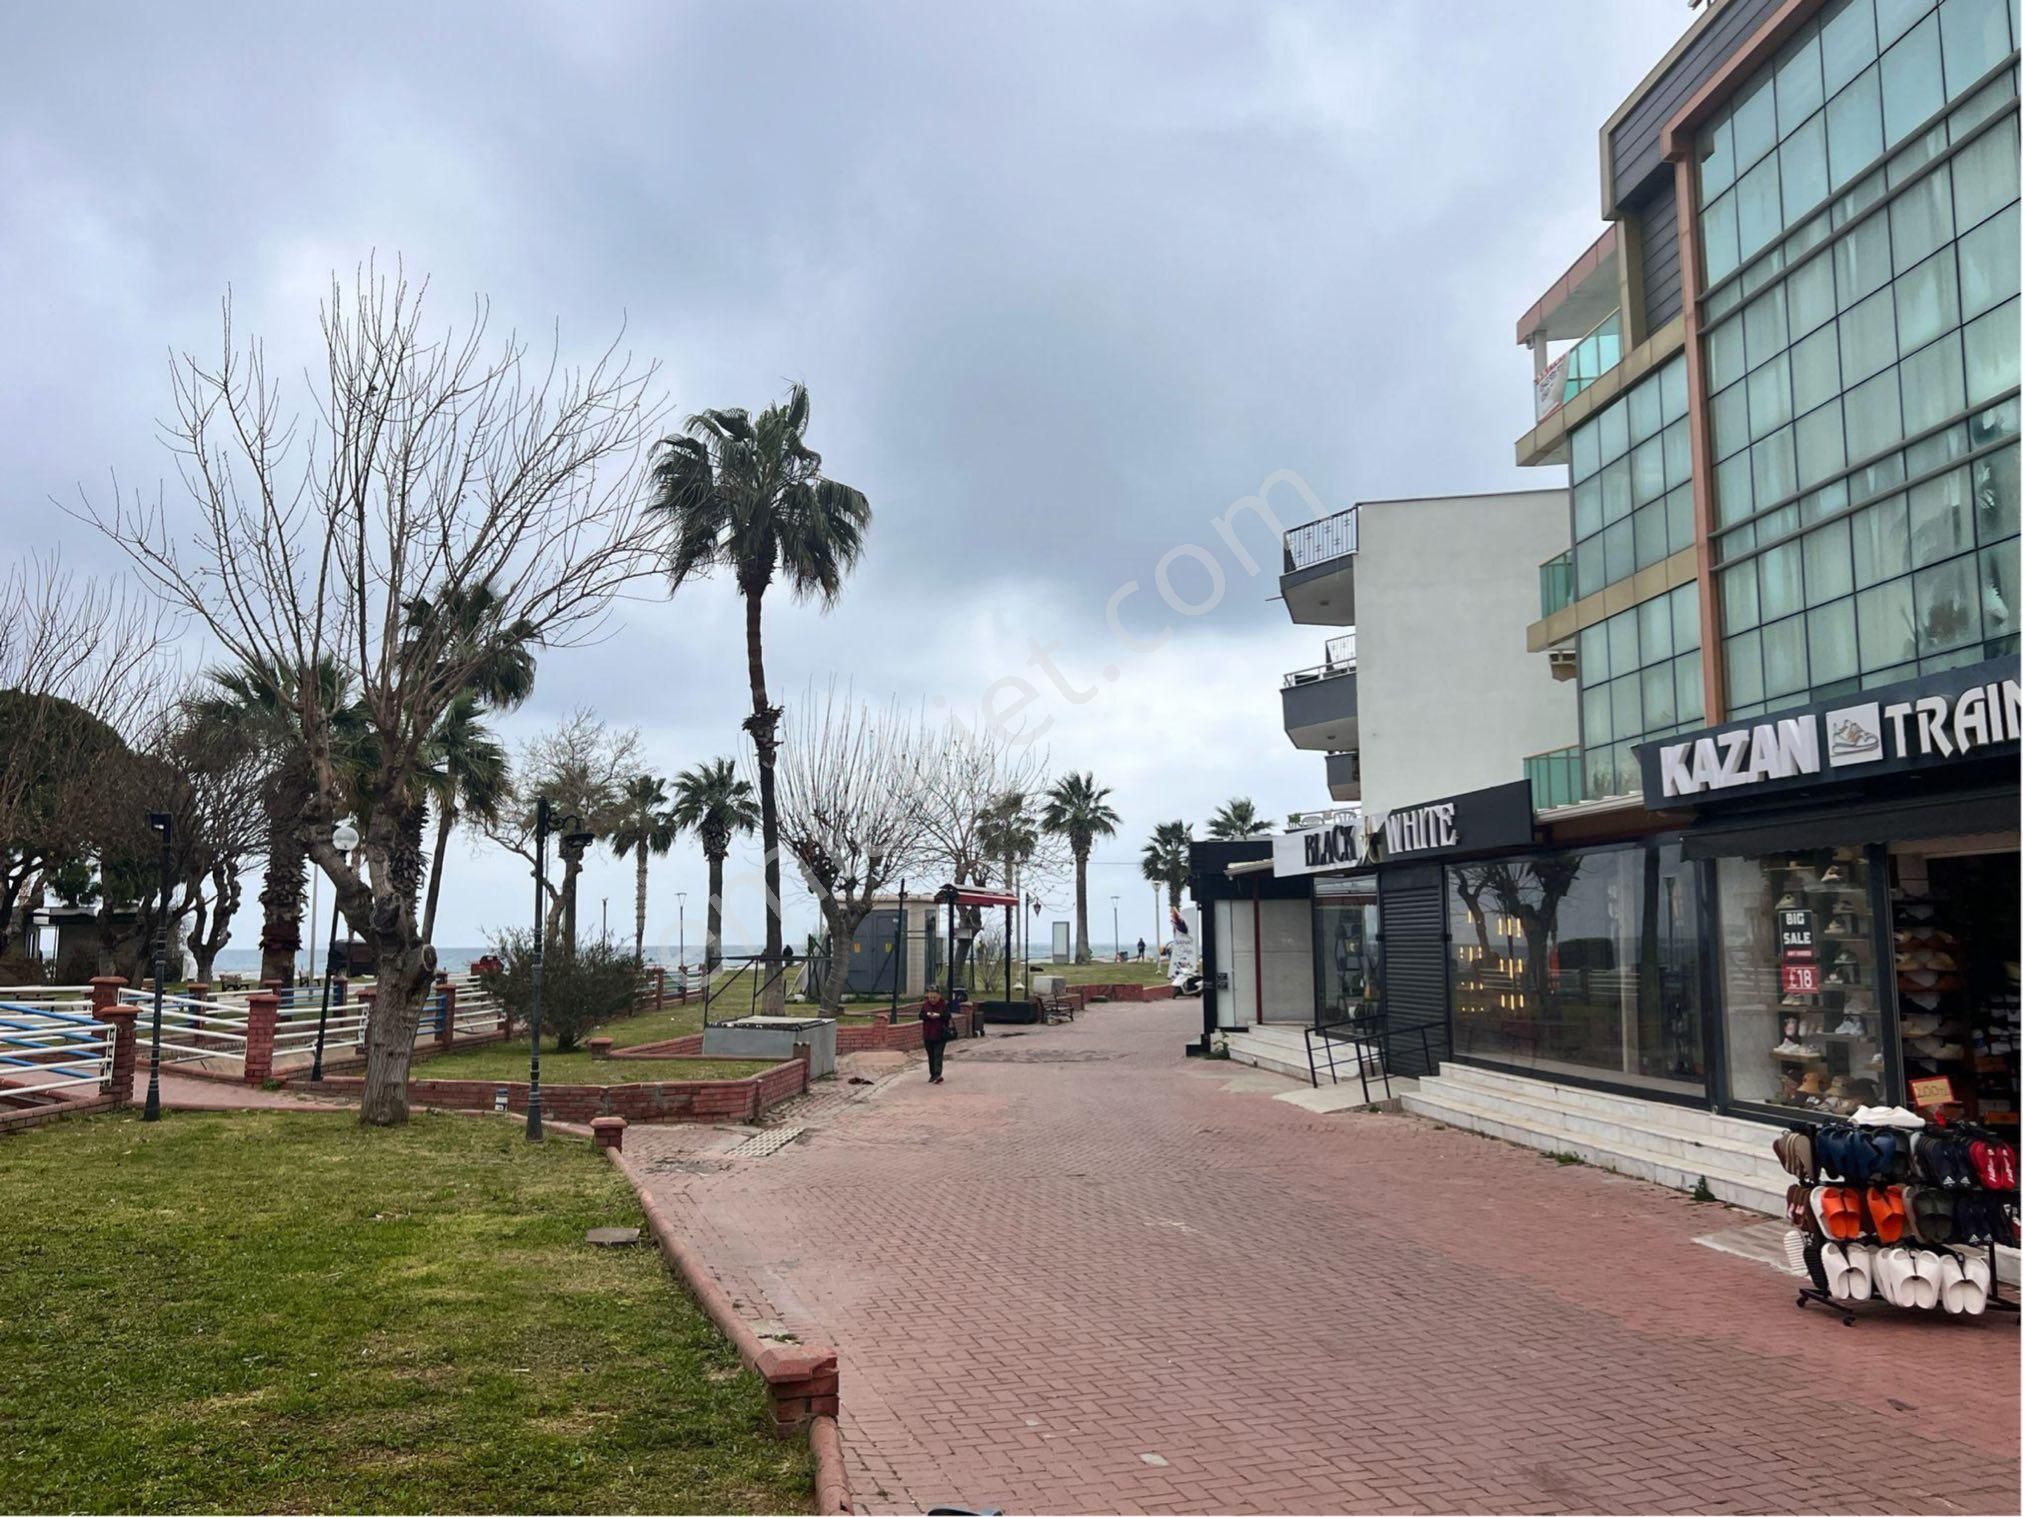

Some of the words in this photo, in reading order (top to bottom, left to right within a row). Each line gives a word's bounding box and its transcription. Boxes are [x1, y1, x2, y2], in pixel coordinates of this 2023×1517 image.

[1660, 714, 1821, 797] KAZAN
[1303, 823, 1359, 867] BLACK
[1384, 802, 1459, 855] WHITE
[1783, 931, 1812, 945] SALE
[1785, 912, 1806, 926] BIG
